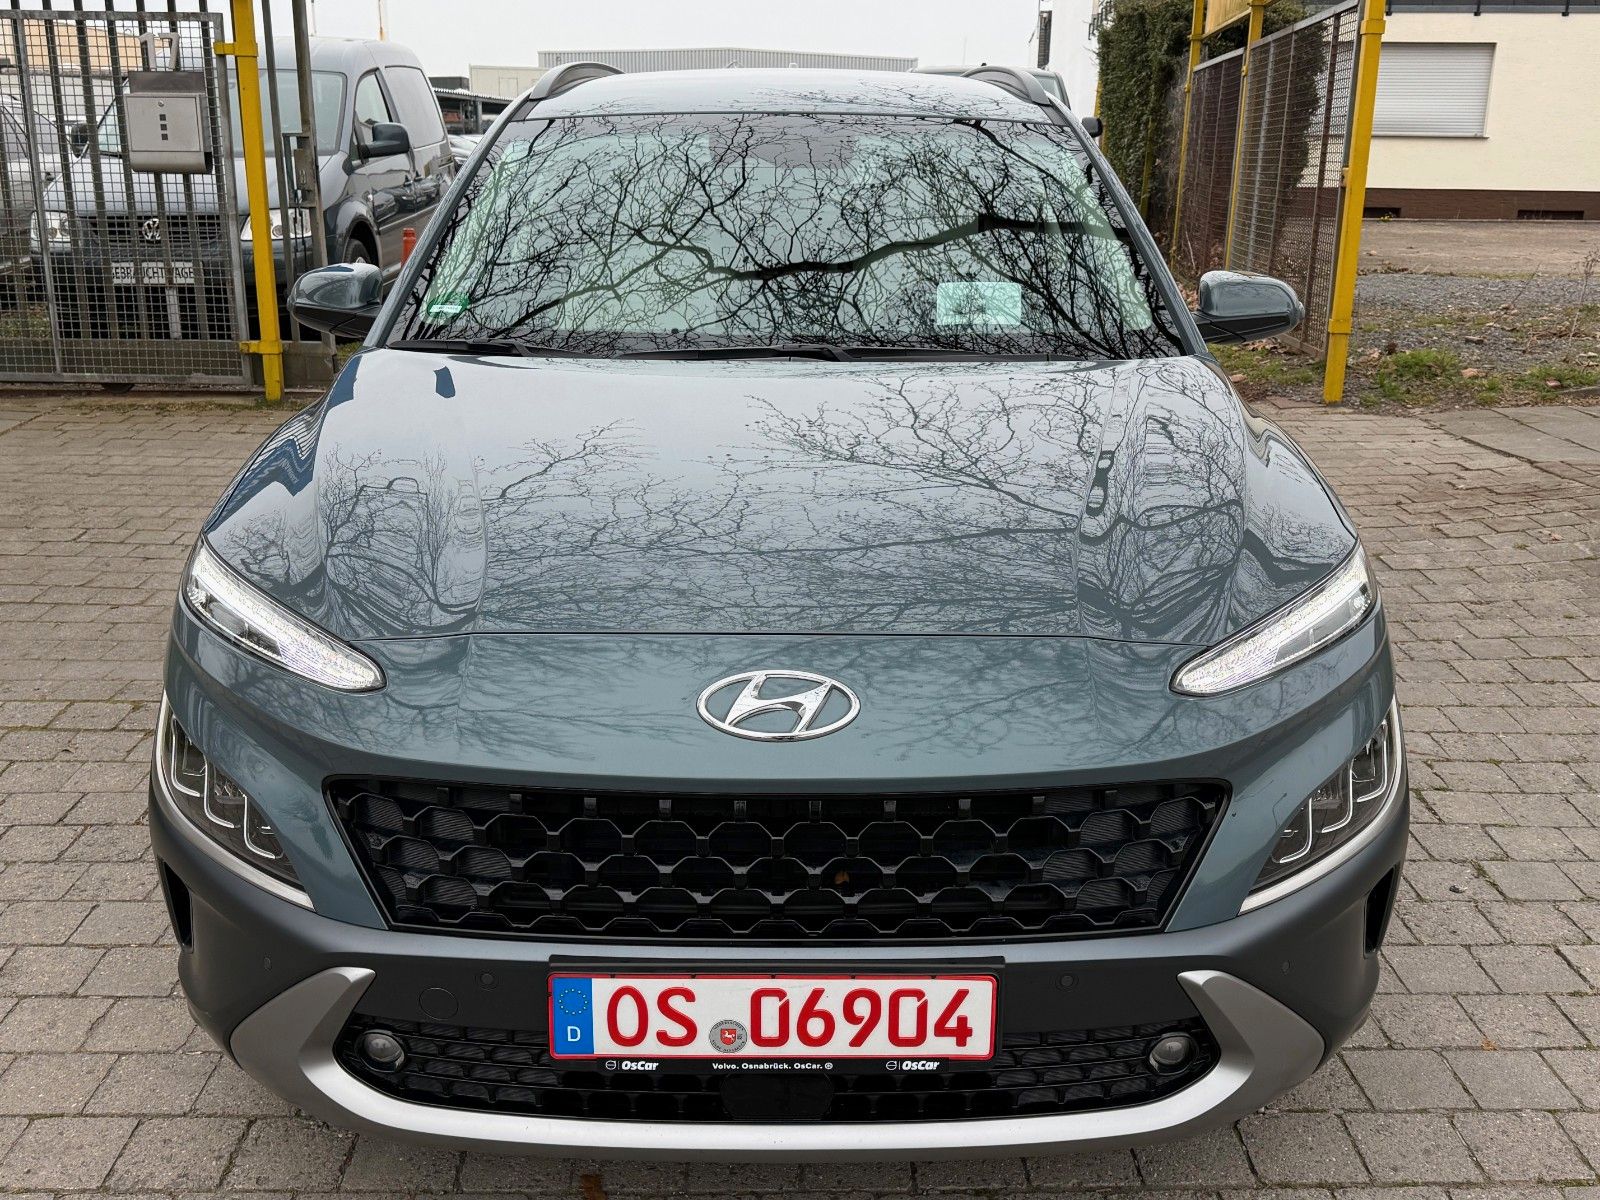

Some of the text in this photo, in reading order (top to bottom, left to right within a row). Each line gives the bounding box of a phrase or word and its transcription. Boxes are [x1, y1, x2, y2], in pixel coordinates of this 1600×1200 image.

[138, 32, 180, 70] 17
[606, 985, 973, 1047] OS 06904
[567, 1026, 581, 1042] D
[621, 1061, 659, 1070] OsCar
[712, 1062, 823, 1070] Volvo. Osnabrück. OsCar.
[902, 1061, 940, 1070] OsCar
